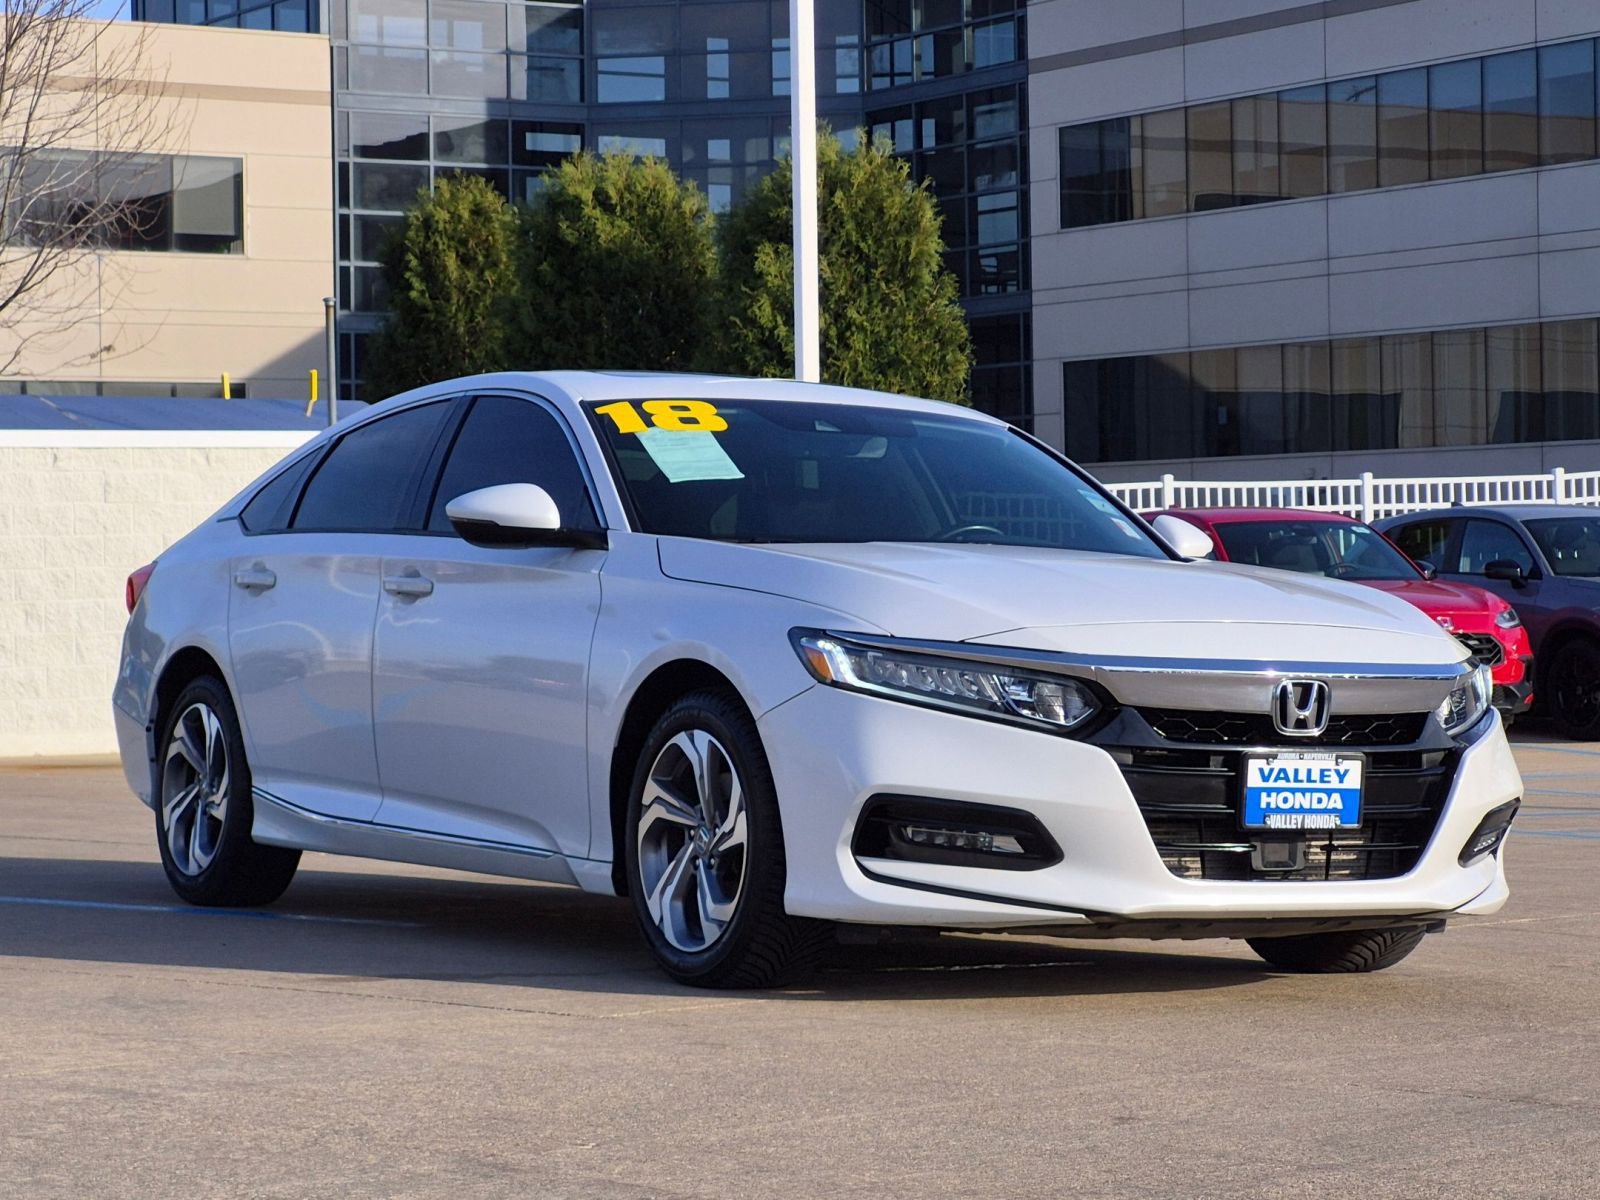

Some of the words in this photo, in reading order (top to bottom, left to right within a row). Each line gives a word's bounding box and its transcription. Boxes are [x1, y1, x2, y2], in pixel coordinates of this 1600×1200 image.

[595, 400, 728, 433] 18
[1258, 767, 1350, 784] VALLEY
[1260, 791, 1343, 809] HONDA
[1270, 814, 1302, 829] VALLEY
[1304, 814, 1336, 829] HONDA
